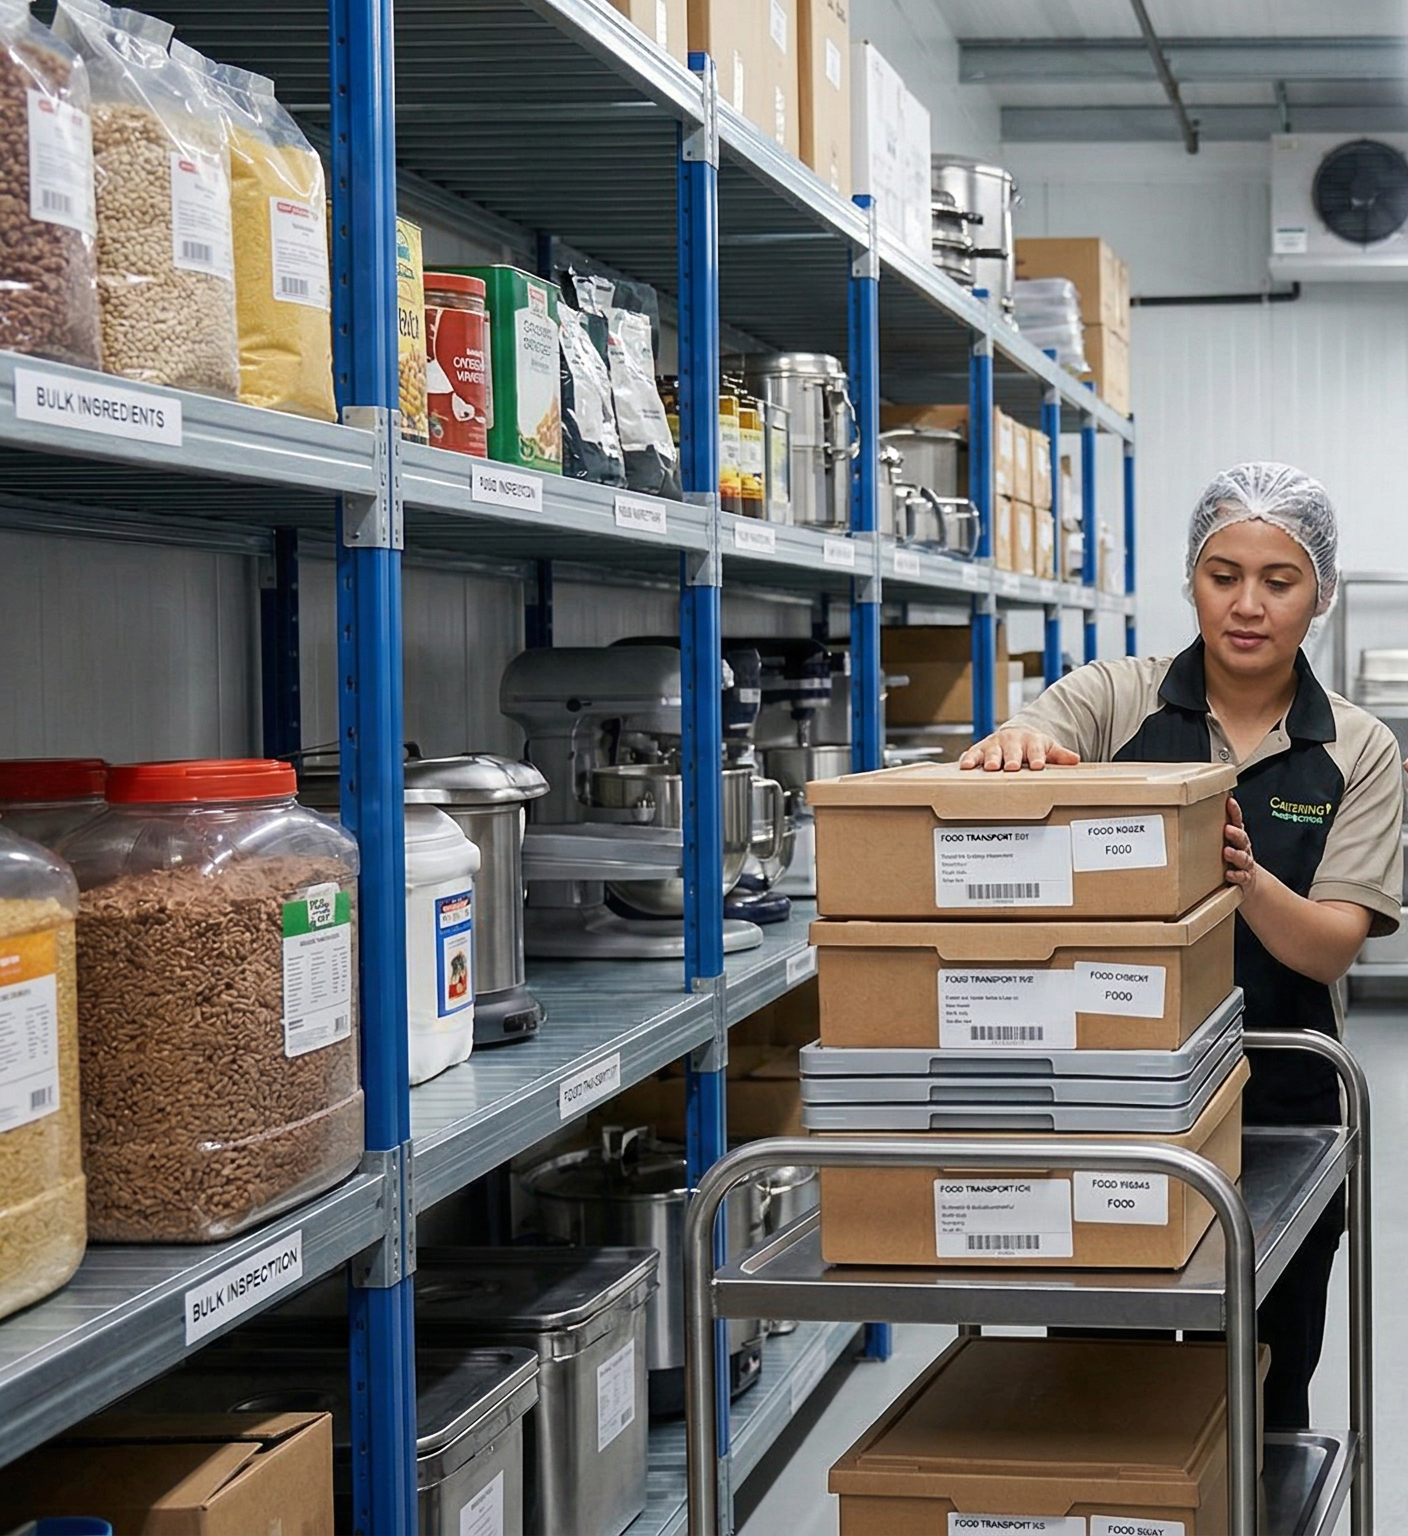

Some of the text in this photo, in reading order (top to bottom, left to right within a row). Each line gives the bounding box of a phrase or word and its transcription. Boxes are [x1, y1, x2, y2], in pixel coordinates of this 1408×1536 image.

[36, 386, 166, 429] BULK INGREDIENTS
[192, 1248, 298, 1323] BULK INSPECTION
